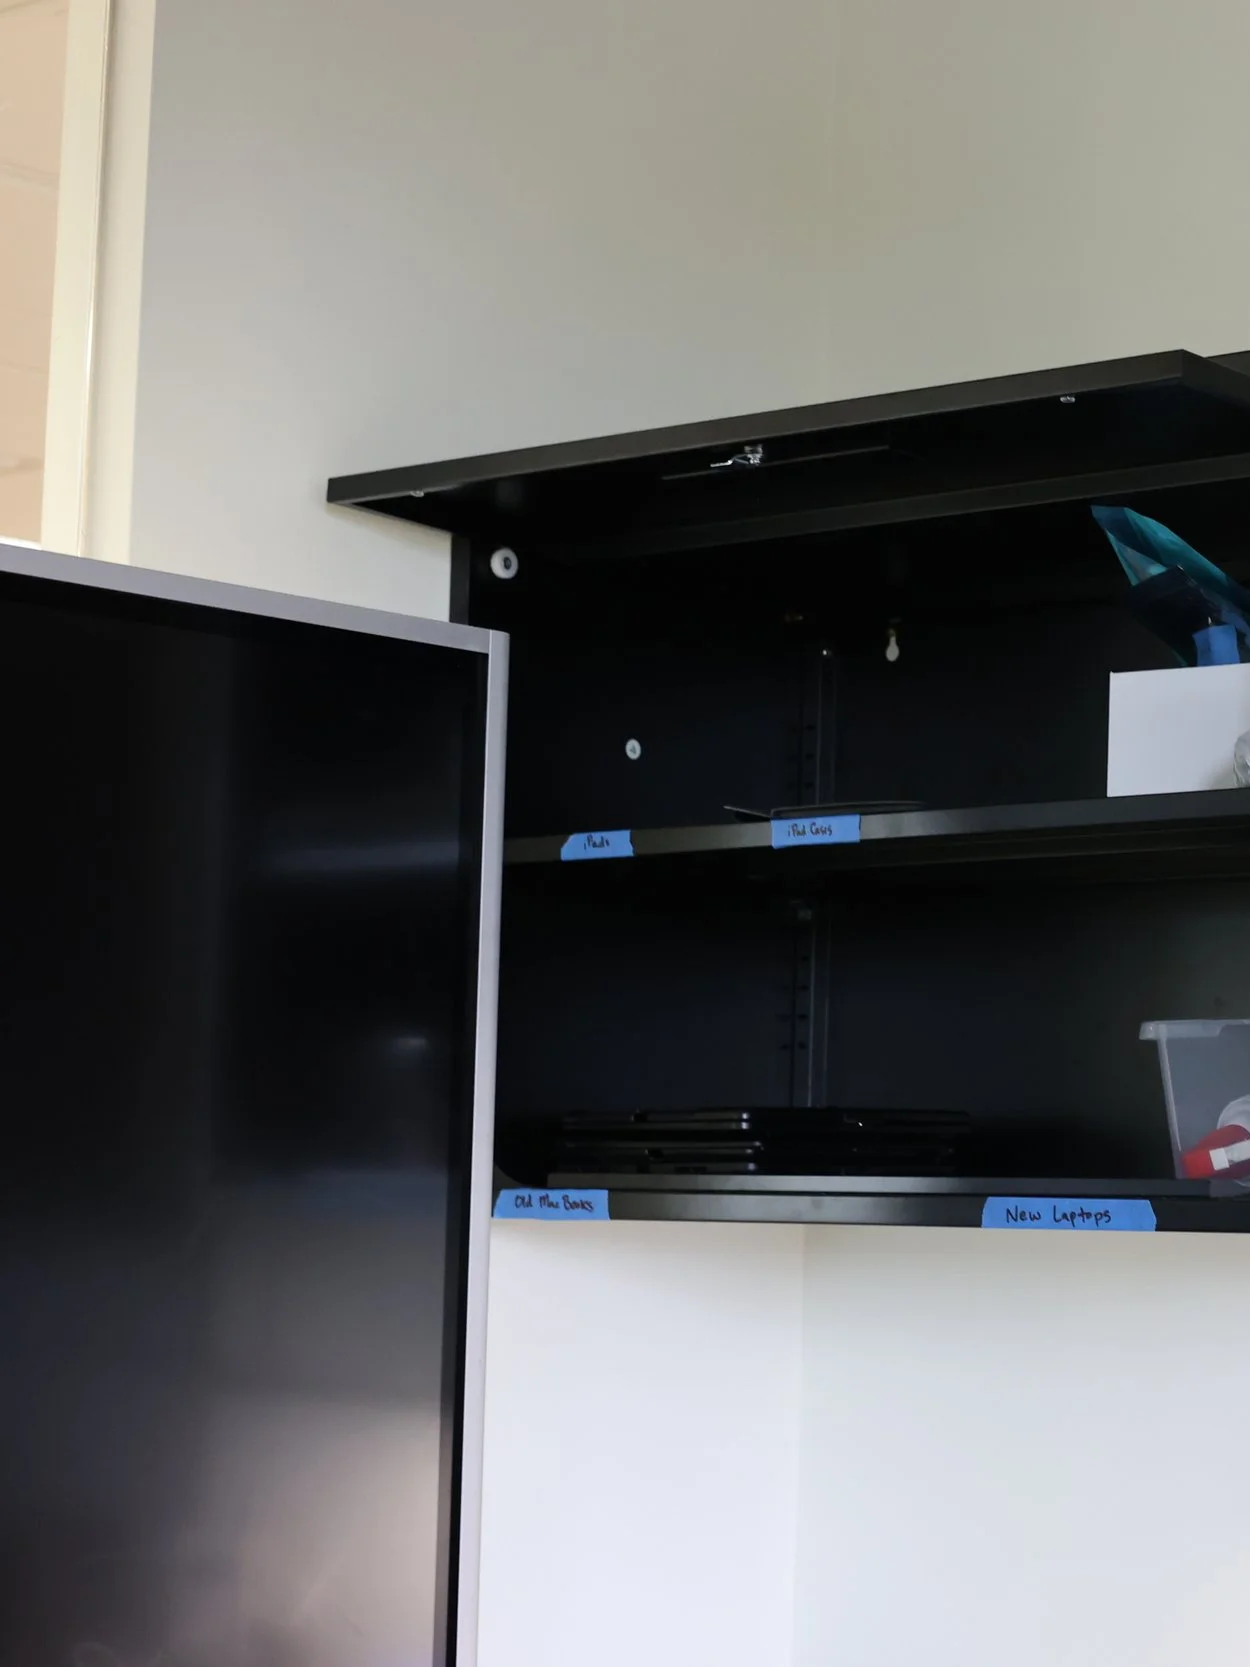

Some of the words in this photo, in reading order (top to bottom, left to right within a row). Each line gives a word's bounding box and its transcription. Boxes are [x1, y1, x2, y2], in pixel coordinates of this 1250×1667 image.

[514, 1193, 533, 1209] Old
[1006, 1204, 1042, 1224] New
[1052, 1204, 1112, 1228] Laptops
